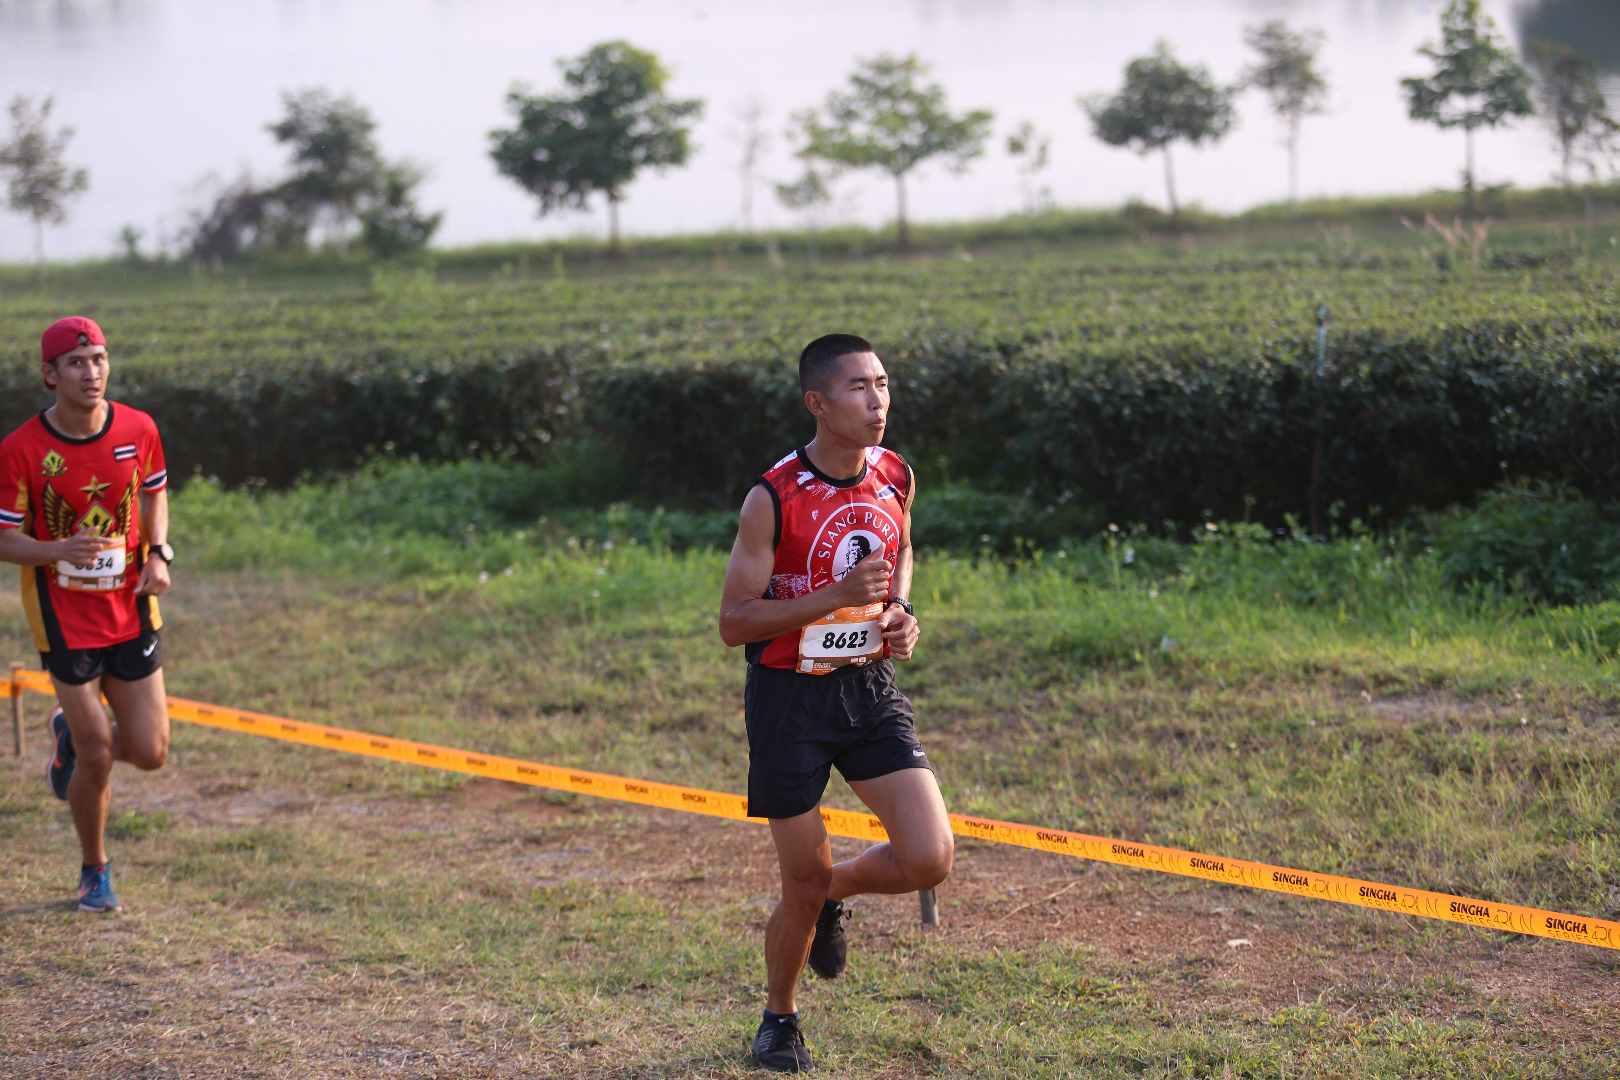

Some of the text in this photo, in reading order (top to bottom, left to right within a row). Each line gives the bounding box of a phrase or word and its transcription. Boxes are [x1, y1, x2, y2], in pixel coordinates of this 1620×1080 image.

[818, 511, 896, 559] SIANG PURE
[822, 630, 868, 649] 8623
[965, 820, 995, 831] SINGHA
[1036, 831, 1068, 845] SINGHA
[1111, 844, 1144, 858] SINGHA
[1190, 857, 1224, 872] SINGHA
[1272, 871, 1309, 887] SINGHA
[1358, 886, 1397, 902] SINGHA
[1360, 897, 1401, 912] SERIES
[1450, 901, 1490, 918] SINGHA
[1451, 912, 1494, 928] SERIES
[1545, 917, 1588, 934] SINGHA
[1547, 929, 1593, 944] SERIES
